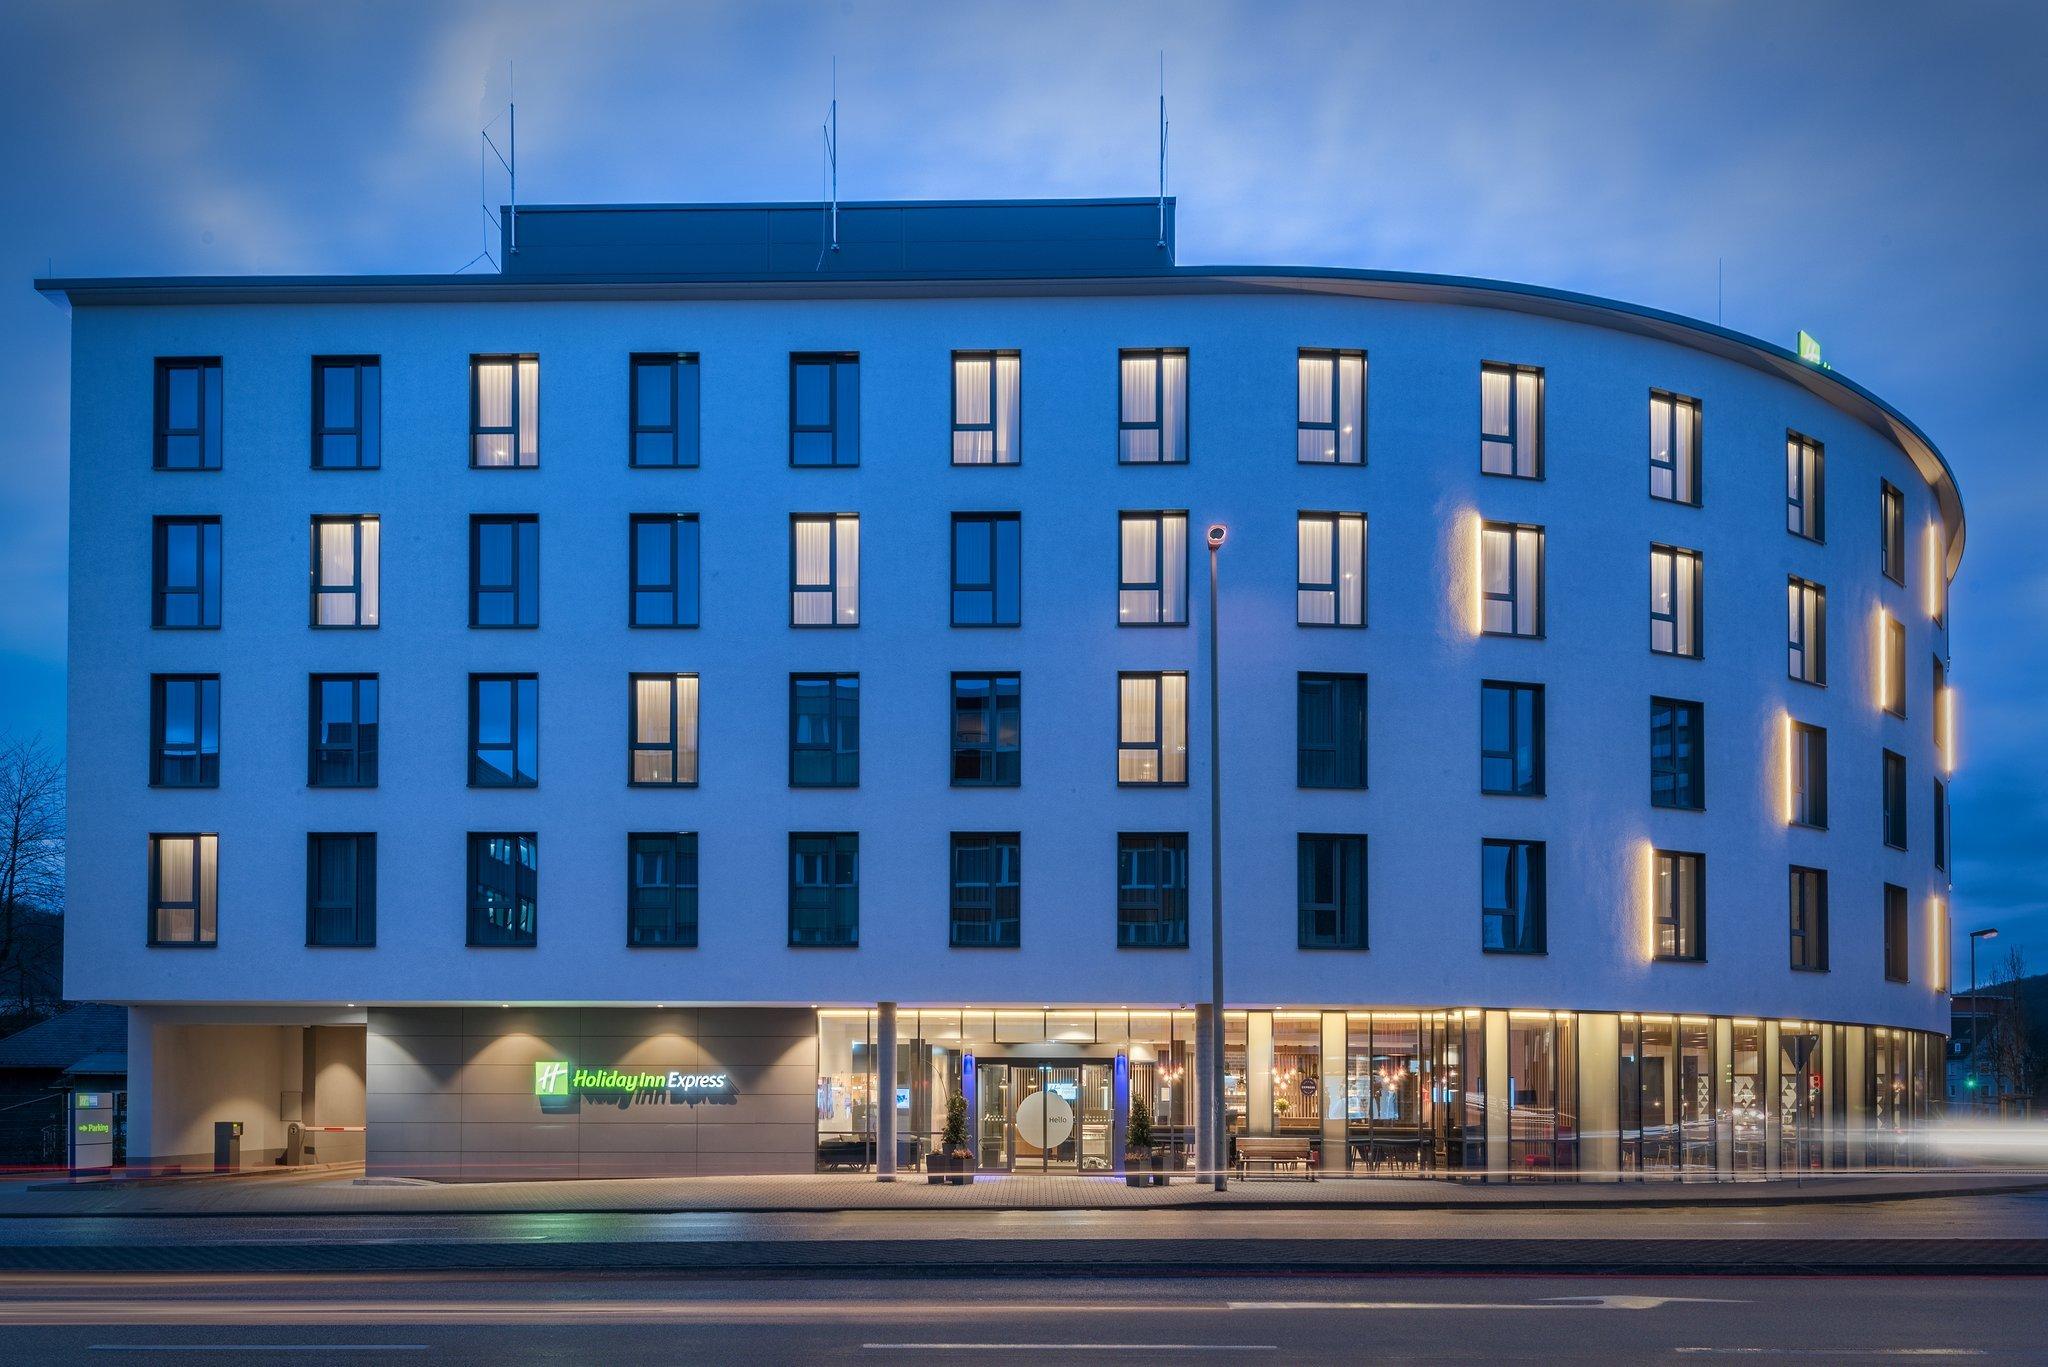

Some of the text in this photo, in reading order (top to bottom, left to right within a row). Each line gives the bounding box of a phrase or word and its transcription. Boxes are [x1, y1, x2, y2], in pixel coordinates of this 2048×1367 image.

[573, 1070, 726, 1091] Holiday Inn Express
[88, 1124, 109, 1133] Parking
